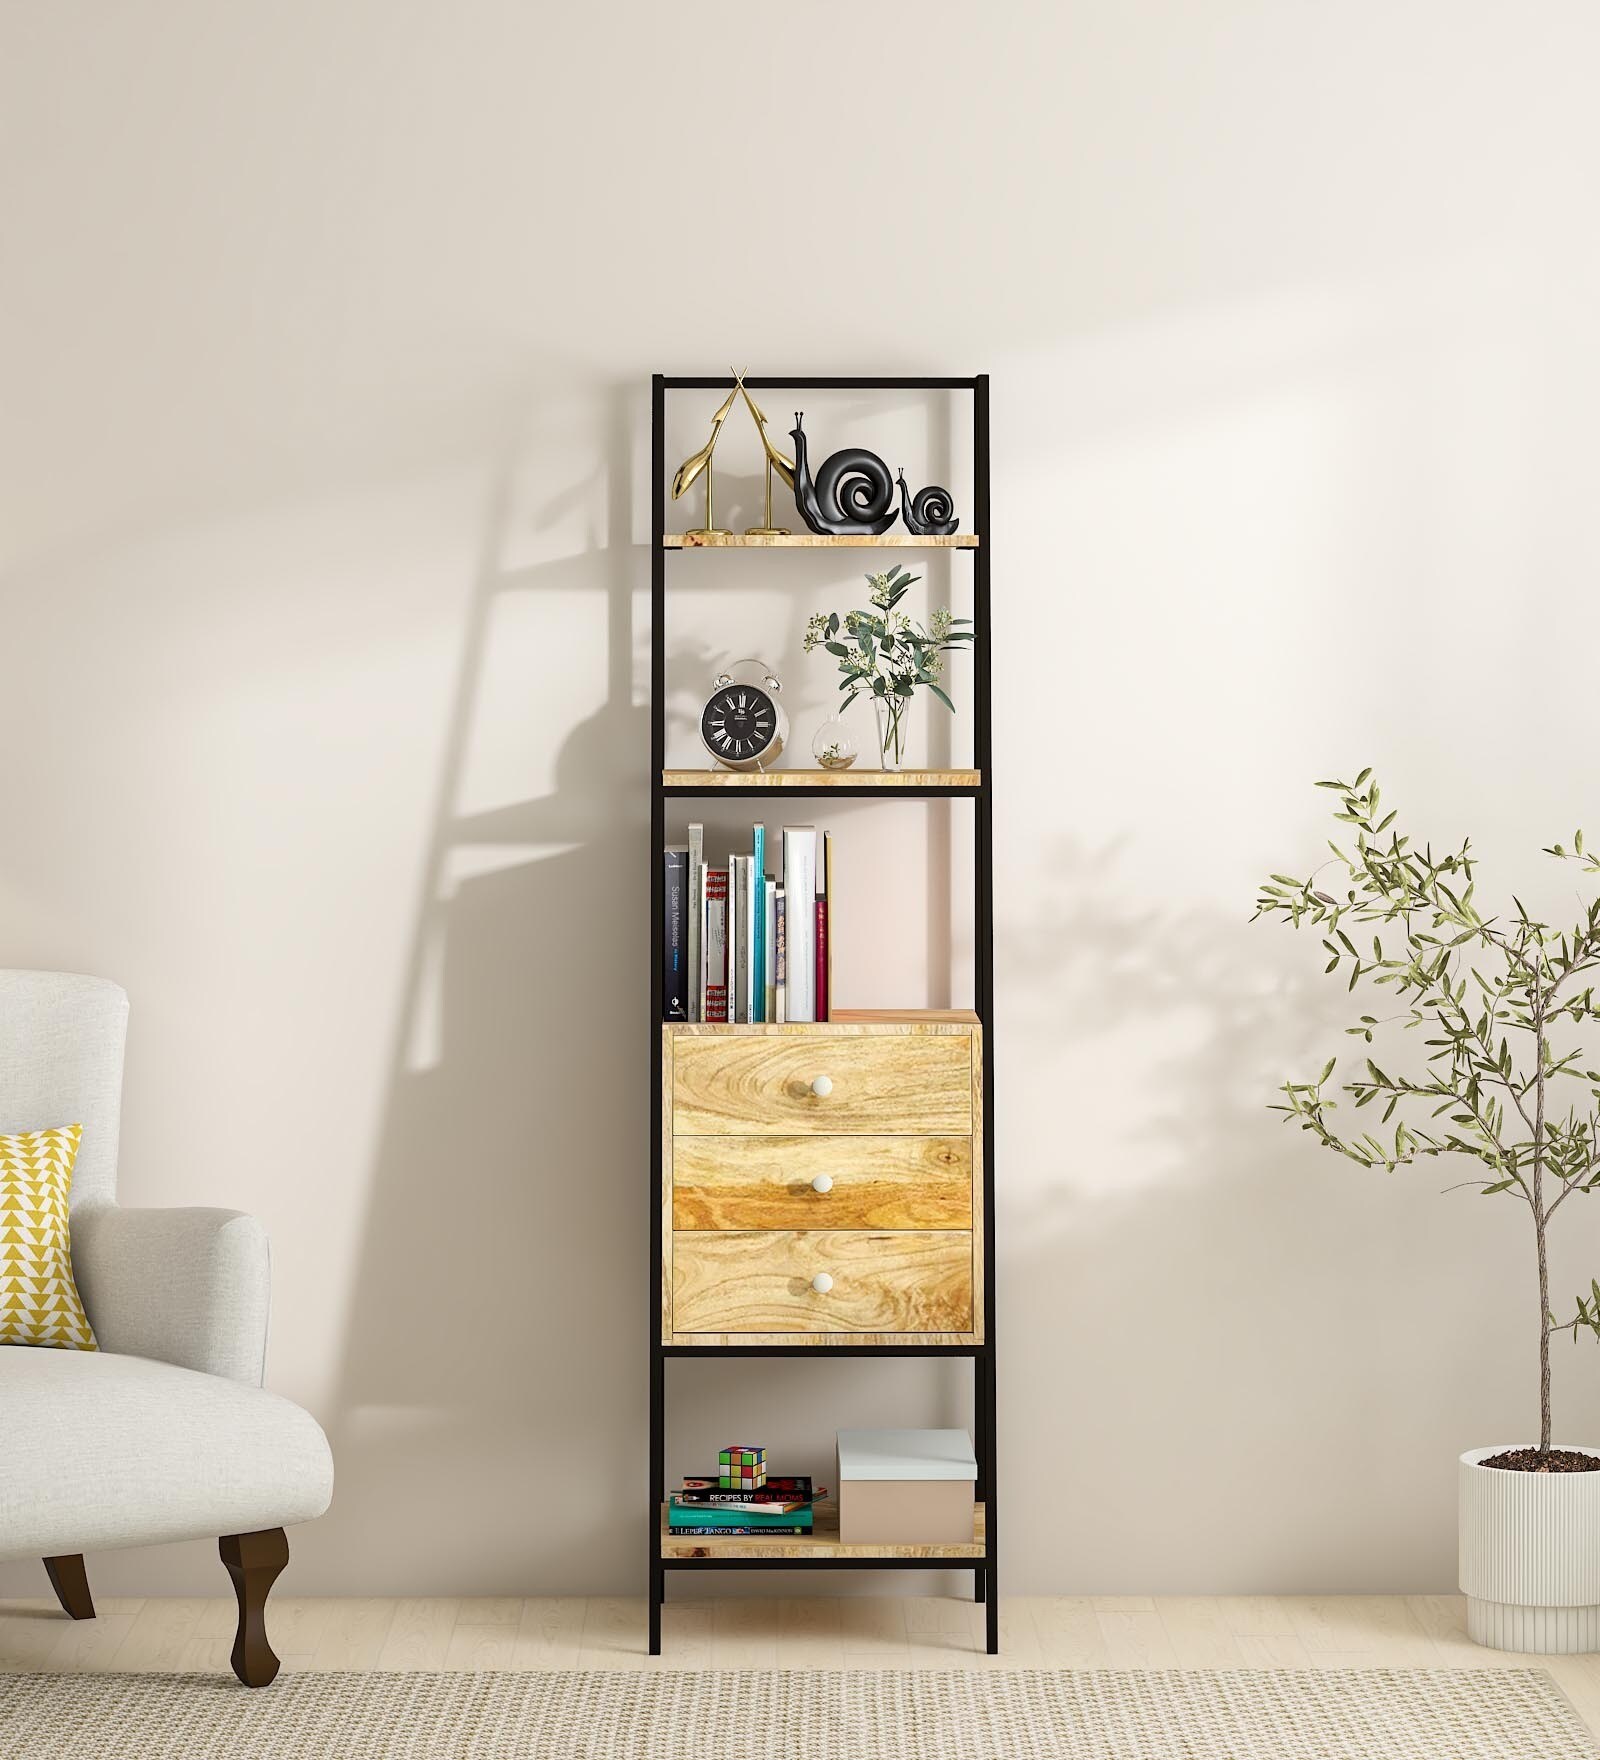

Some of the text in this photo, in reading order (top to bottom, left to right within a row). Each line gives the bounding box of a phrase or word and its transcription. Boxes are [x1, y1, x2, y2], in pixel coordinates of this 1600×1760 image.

[671, 886, 680, 910] Susan
[709, 1494, 803, 1502] RECIPES BY REAL MOMS
[704, 1527, 732, 1535] TANGO
